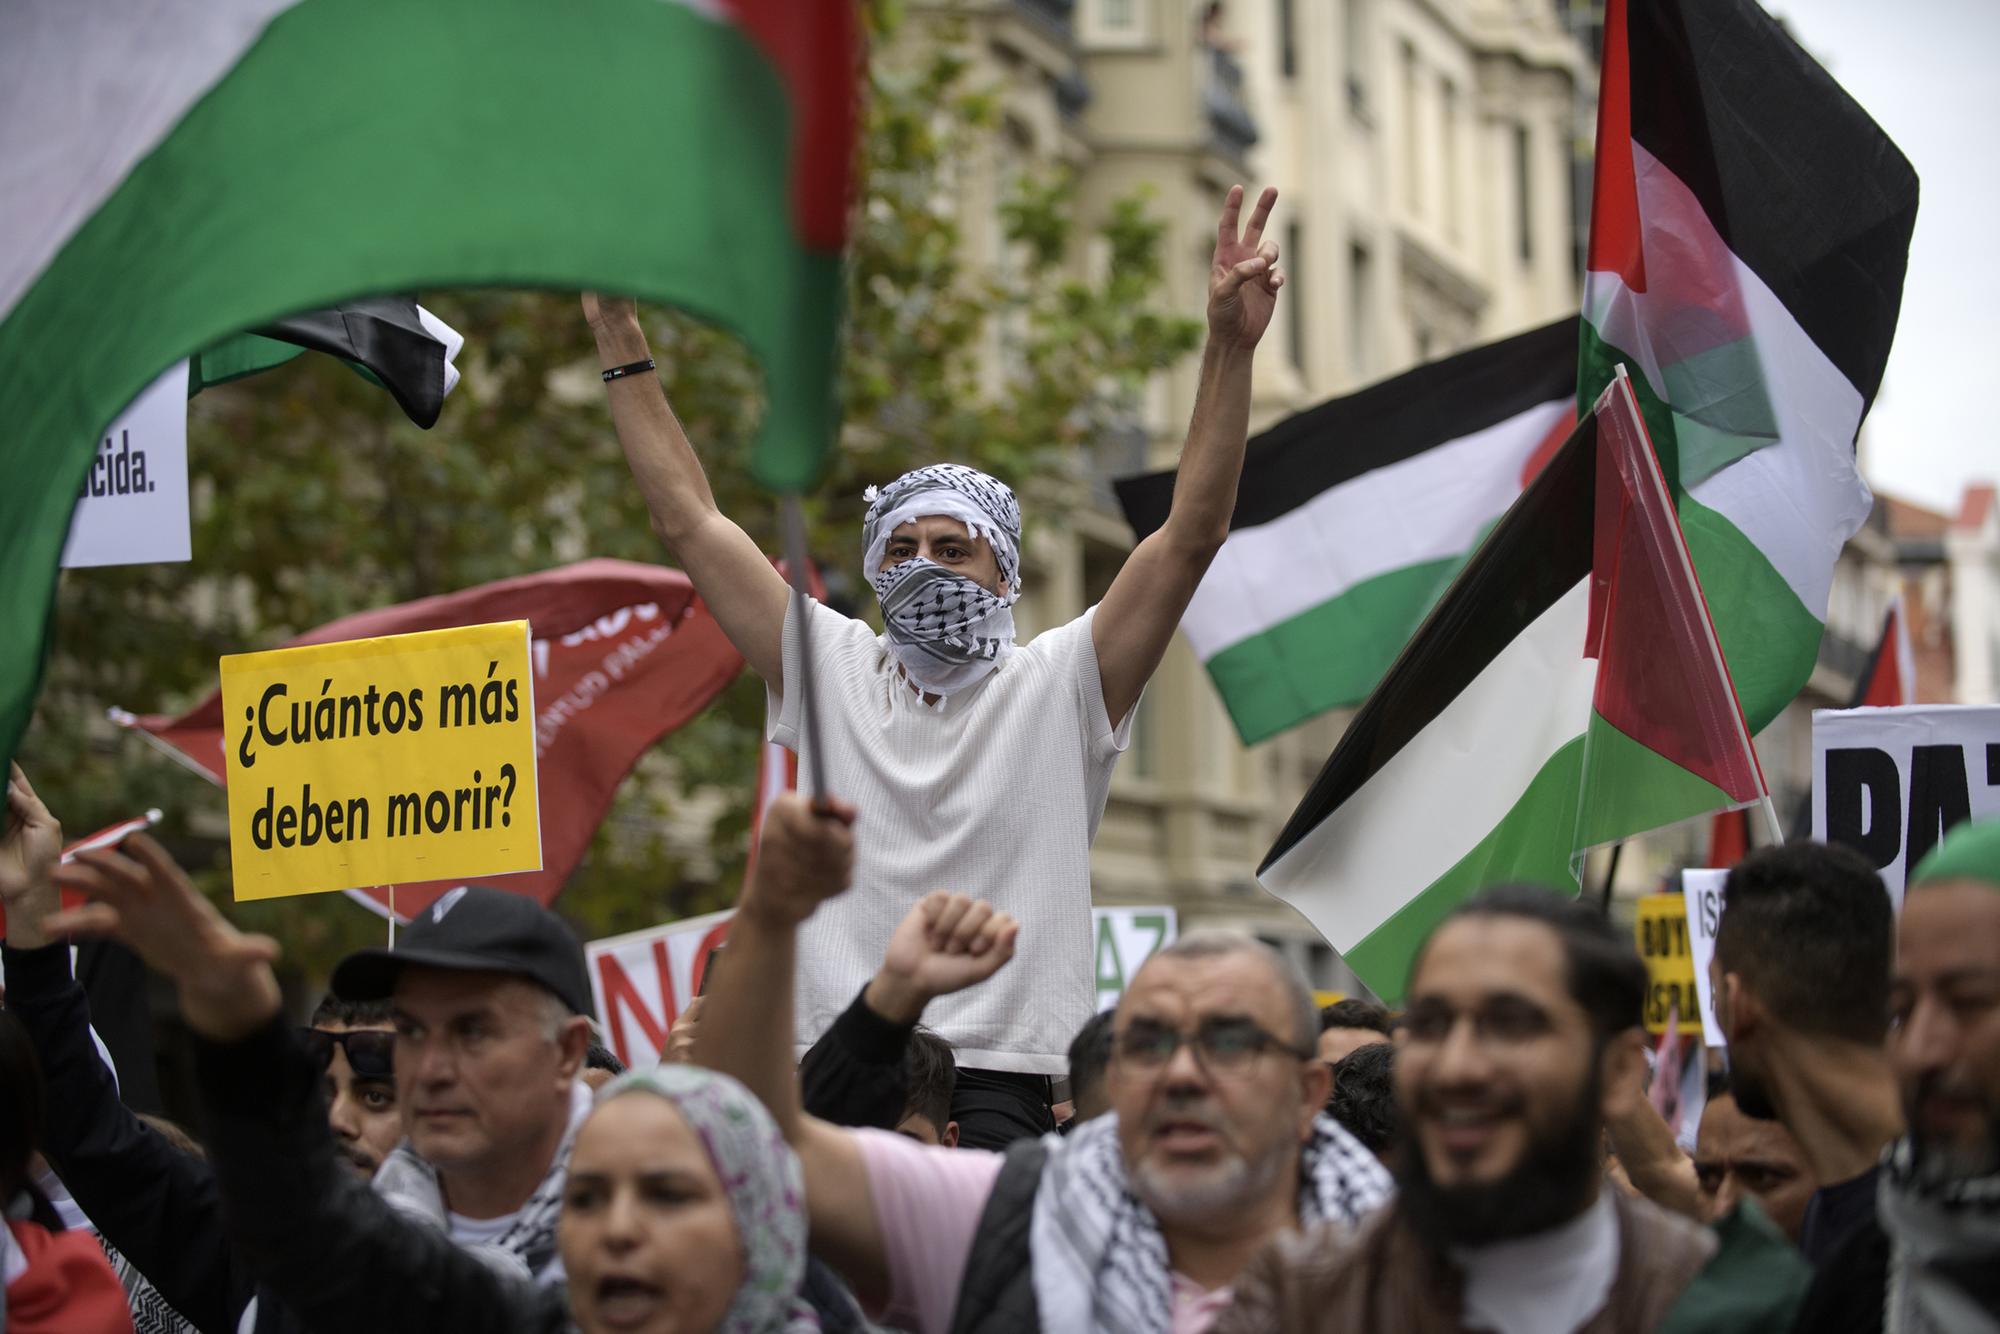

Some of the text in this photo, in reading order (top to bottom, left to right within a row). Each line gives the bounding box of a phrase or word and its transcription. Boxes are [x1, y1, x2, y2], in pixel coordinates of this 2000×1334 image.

[79, 429, 155, 498] cida.
[239, 660, 519, 769] ¿Cuántos más
[251, 763, 517, 851] deben morir?
[1825, 742, 2000, 898] PA
